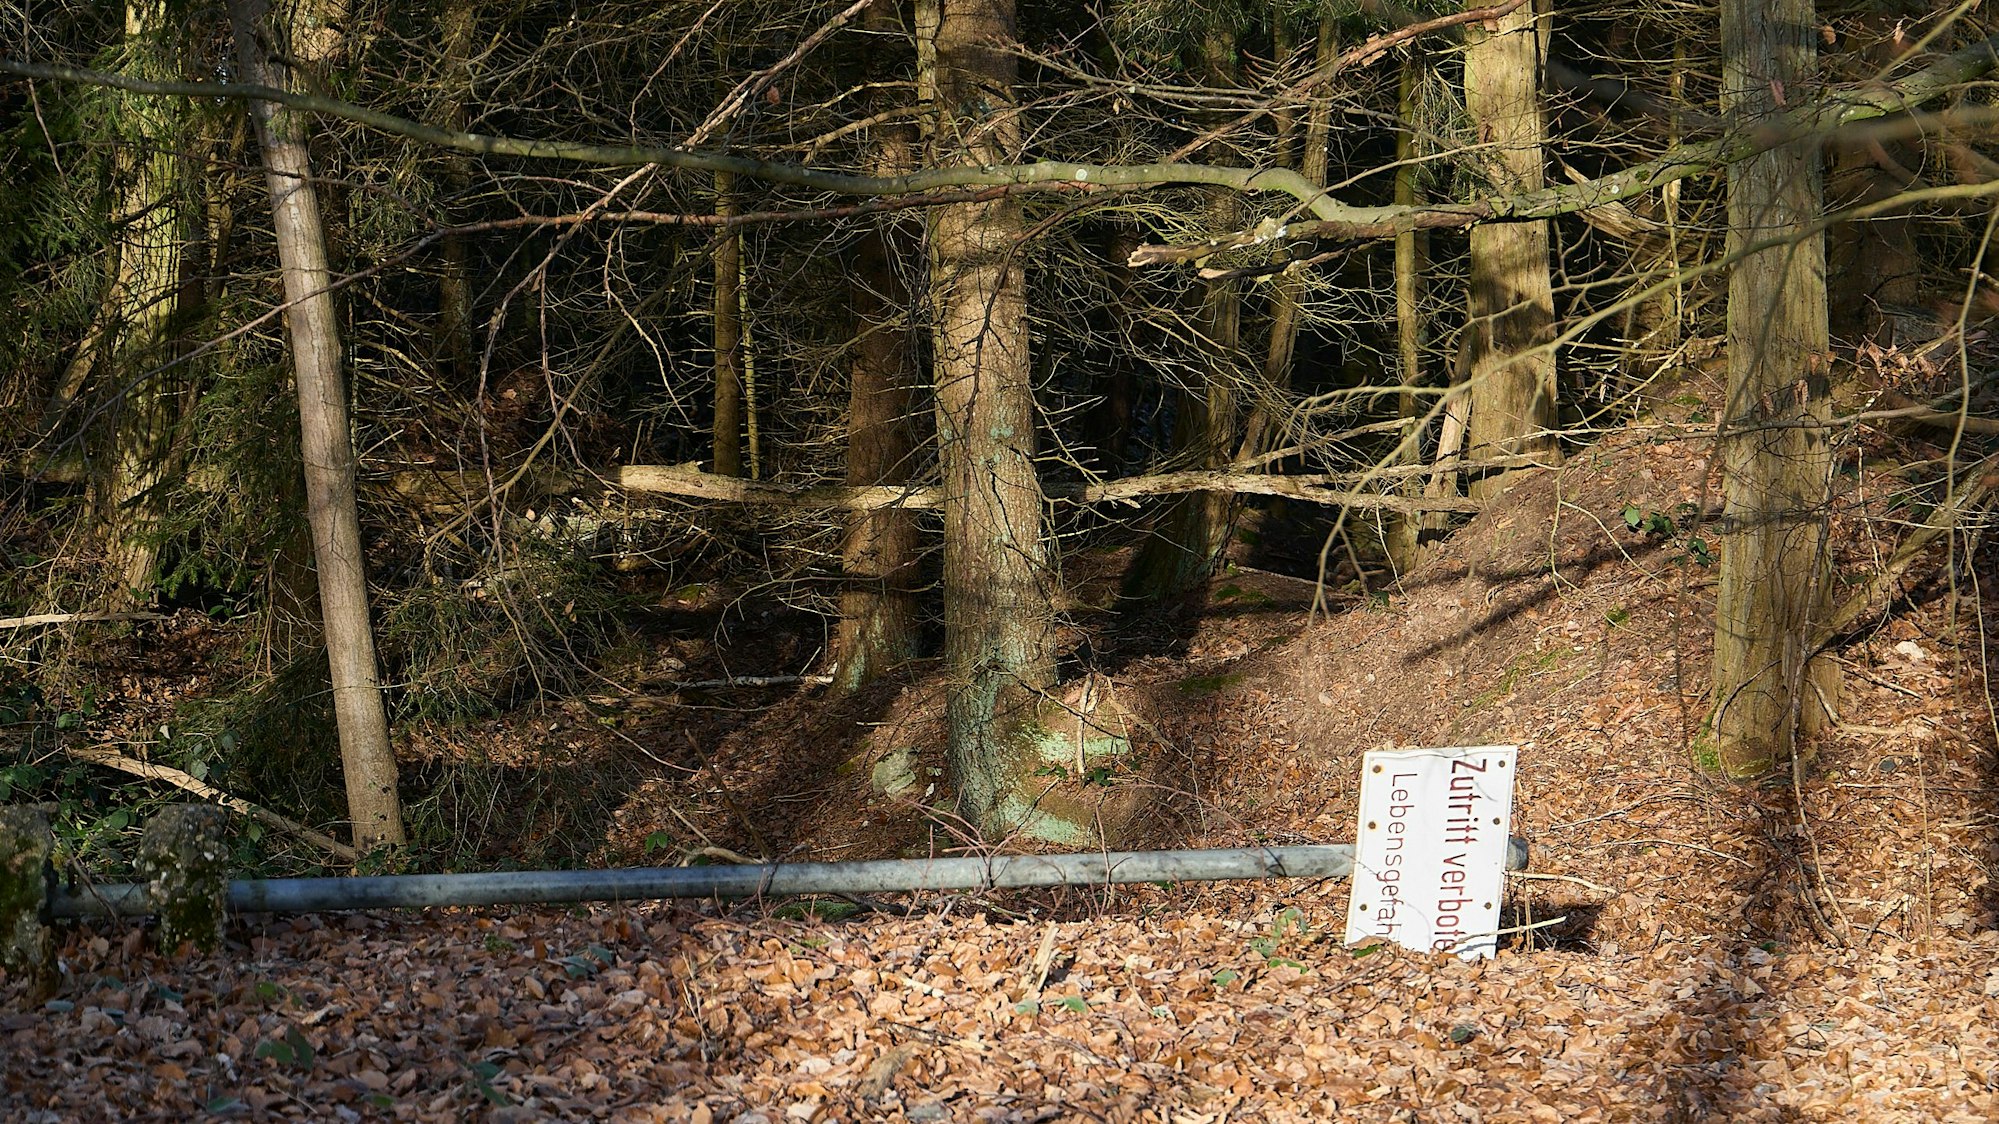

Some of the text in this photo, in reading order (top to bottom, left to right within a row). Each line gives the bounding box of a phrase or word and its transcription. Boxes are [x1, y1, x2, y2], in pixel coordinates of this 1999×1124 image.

[1375, 773, 1417, 935] Lebensgefah
[1433, 758, 1487, 951] Zutritt verbote
